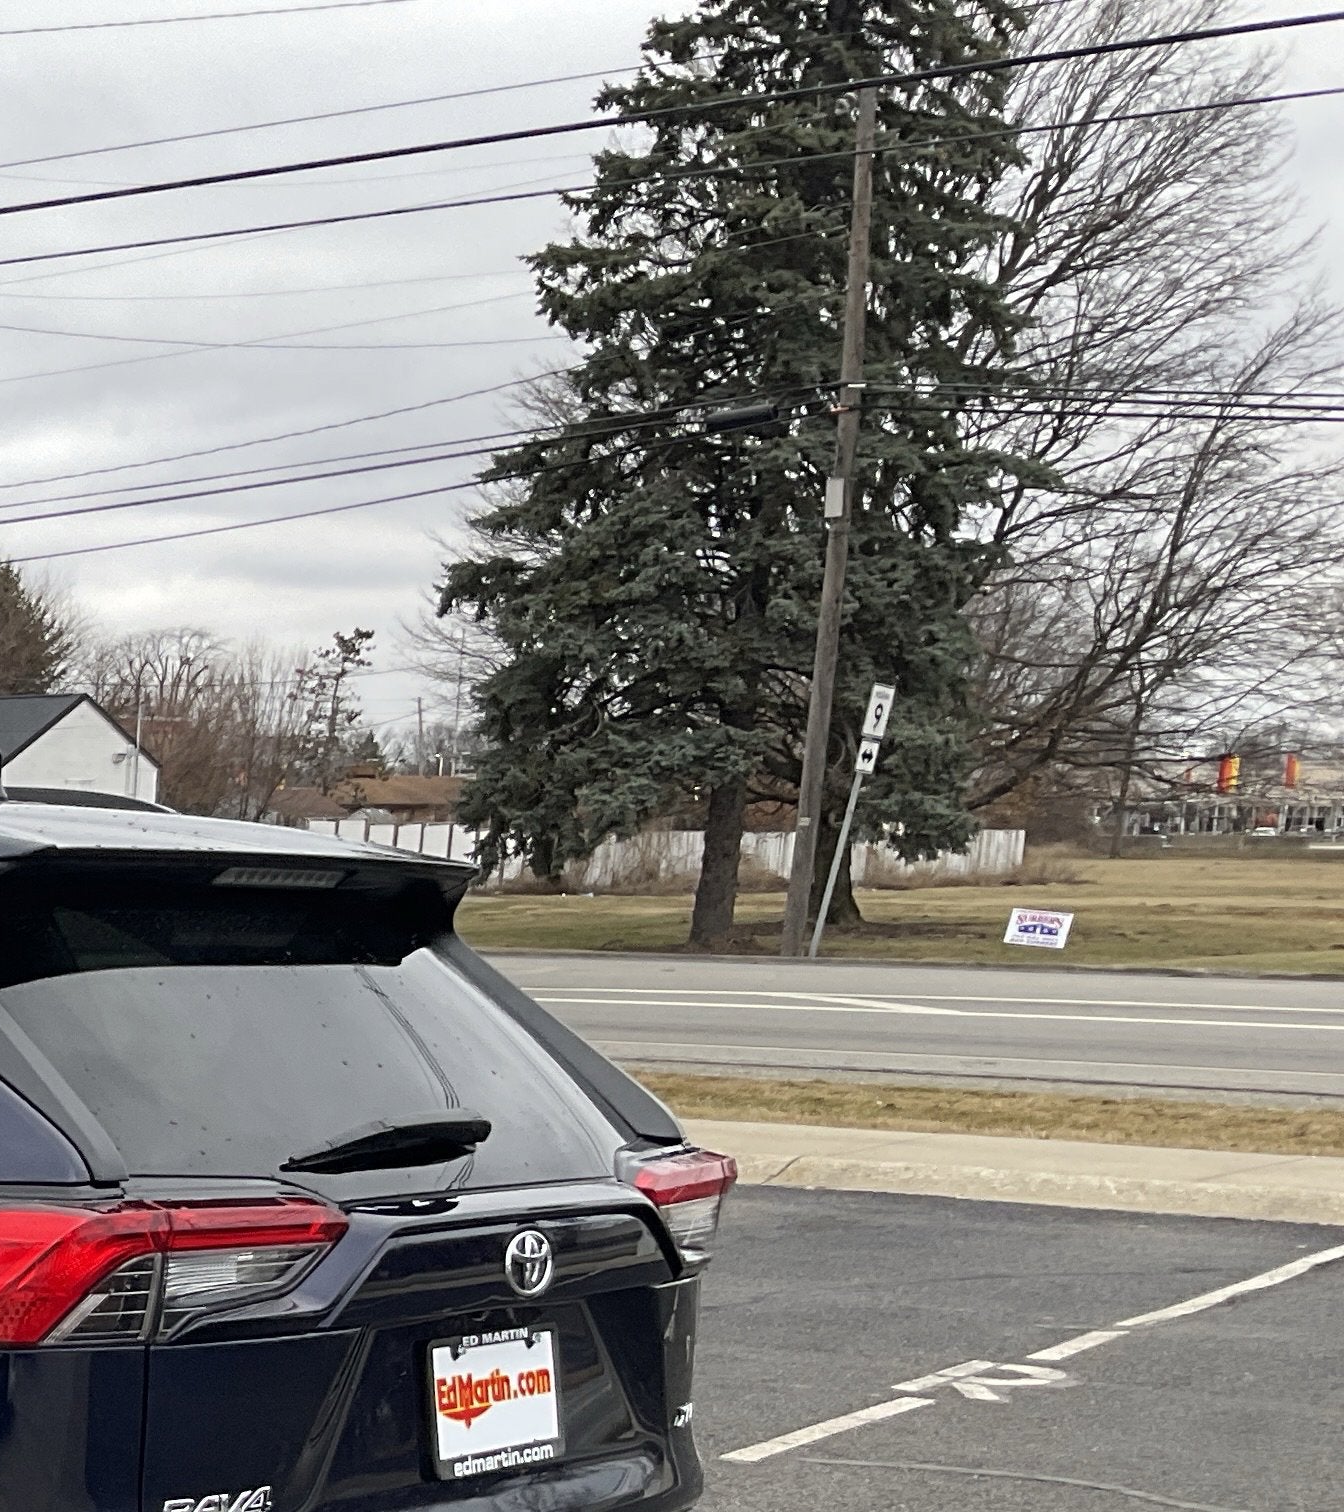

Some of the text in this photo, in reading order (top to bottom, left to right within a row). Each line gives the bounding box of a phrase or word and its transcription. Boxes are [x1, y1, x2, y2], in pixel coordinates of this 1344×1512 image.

[461, 1327, 529, 1347] ED MARTIN
[435, 1367, 552, 1413] EdMartin.com
[453, 1443, 555, 1477] edmartin.com
